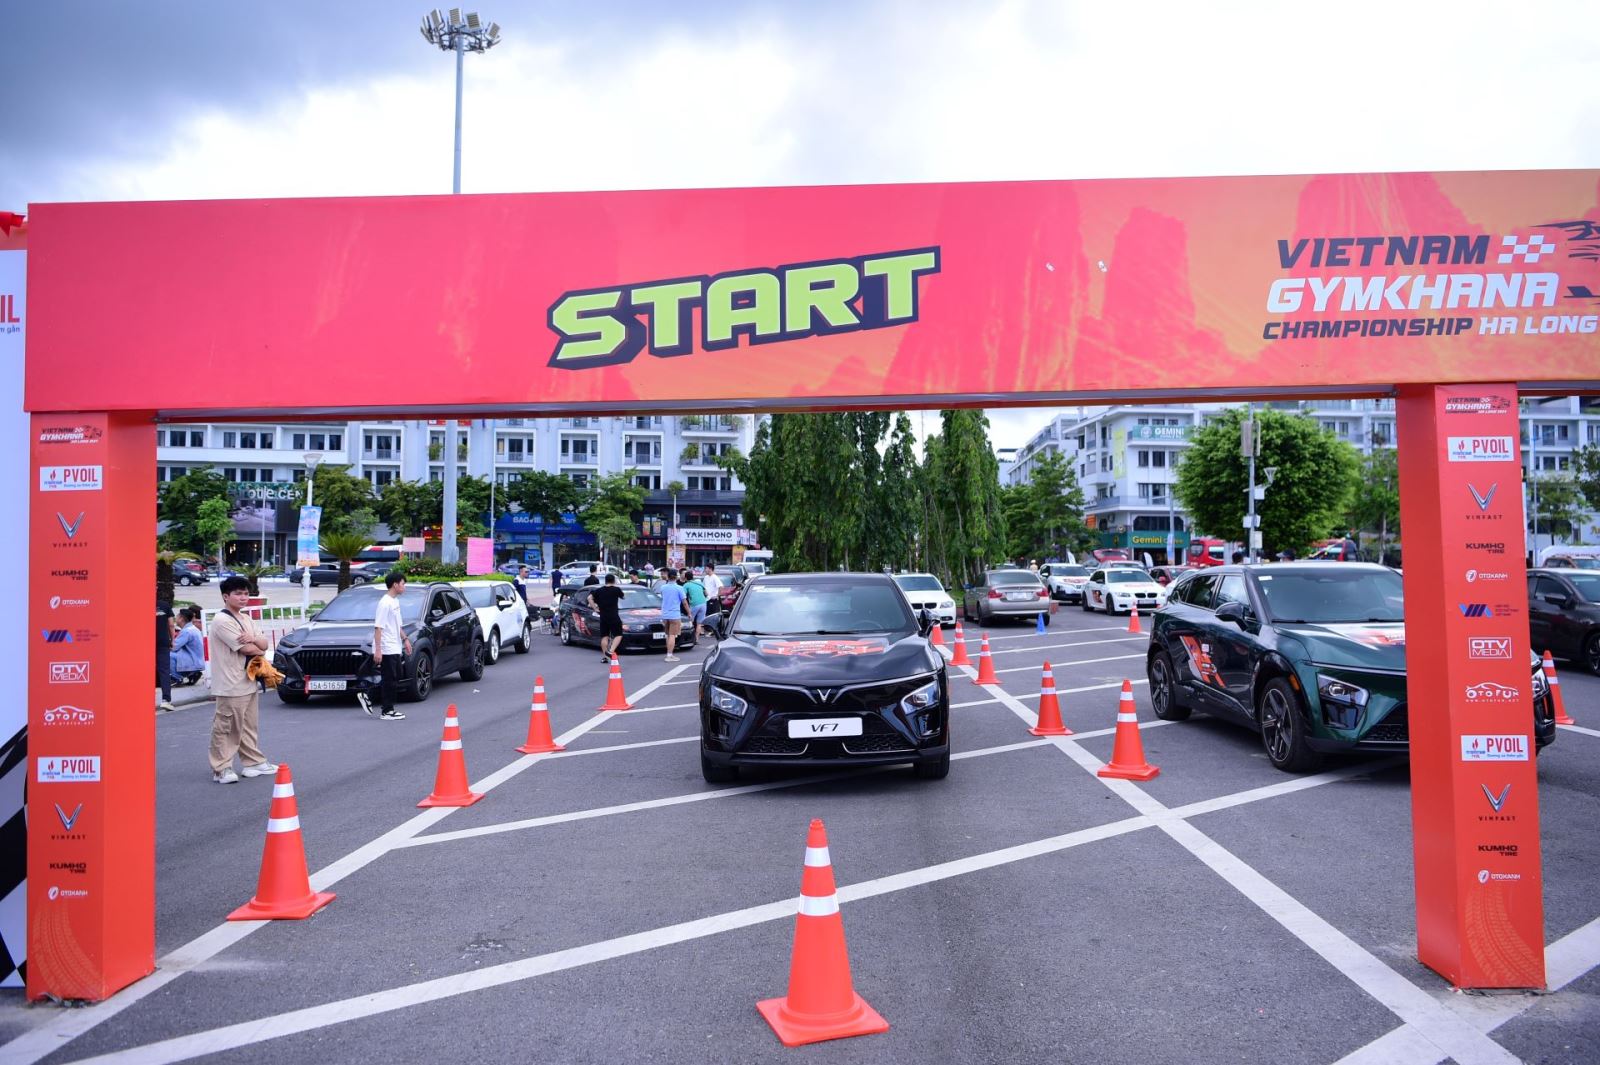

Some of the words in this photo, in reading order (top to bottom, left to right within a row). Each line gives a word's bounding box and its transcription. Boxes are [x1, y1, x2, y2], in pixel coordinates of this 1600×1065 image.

[1277, 235, 1490, 269] VIETNAM
[1266, 272, 1560, 313] GYMKHANA
[549, 247, 939, 367] START
[1262, 317, 1473, 340] CHAMPIONSHIP
[1477, 316, 1518, 335] HA
[1523, 315, 1599, 334] LONG
[1472, 438, 1509, 454] PVOIL
[63, 468, 98, 483] PVOIL
[685, 531, 733, 539] YAKIMONO
[1132, 535, 1162, 544] Gemini
[1472, 648, 1509, 657] MEDIA
[52, 673, 87, 681] MEDIA
[1486, 737, 1524, 753] PVOIL
[61, 759, 96, 774] PVOIL
